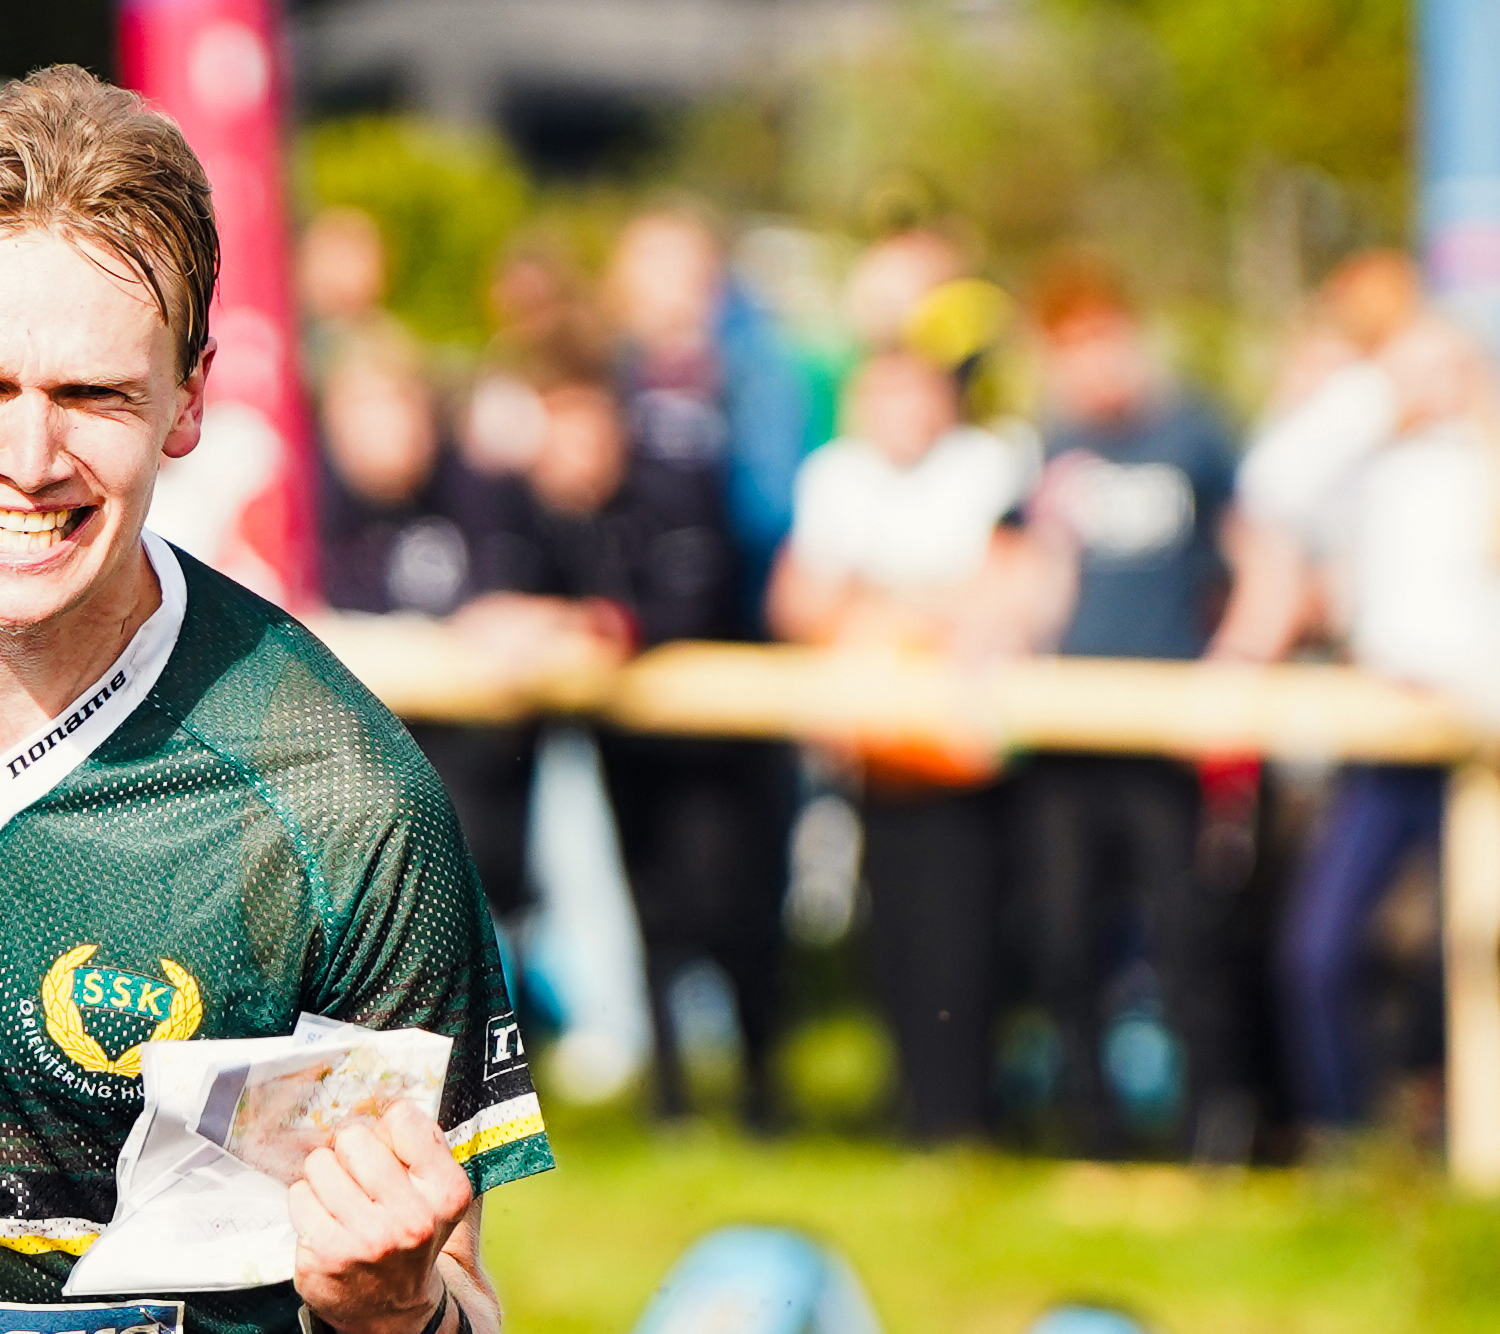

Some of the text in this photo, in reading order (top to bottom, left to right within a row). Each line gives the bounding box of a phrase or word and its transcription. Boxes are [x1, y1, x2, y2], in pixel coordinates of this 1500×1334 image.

[6, 670, 127, 780] noname
[82, 973, 168, 1015] SSK
[19, 999, 113, 1099] ORIENTERING
